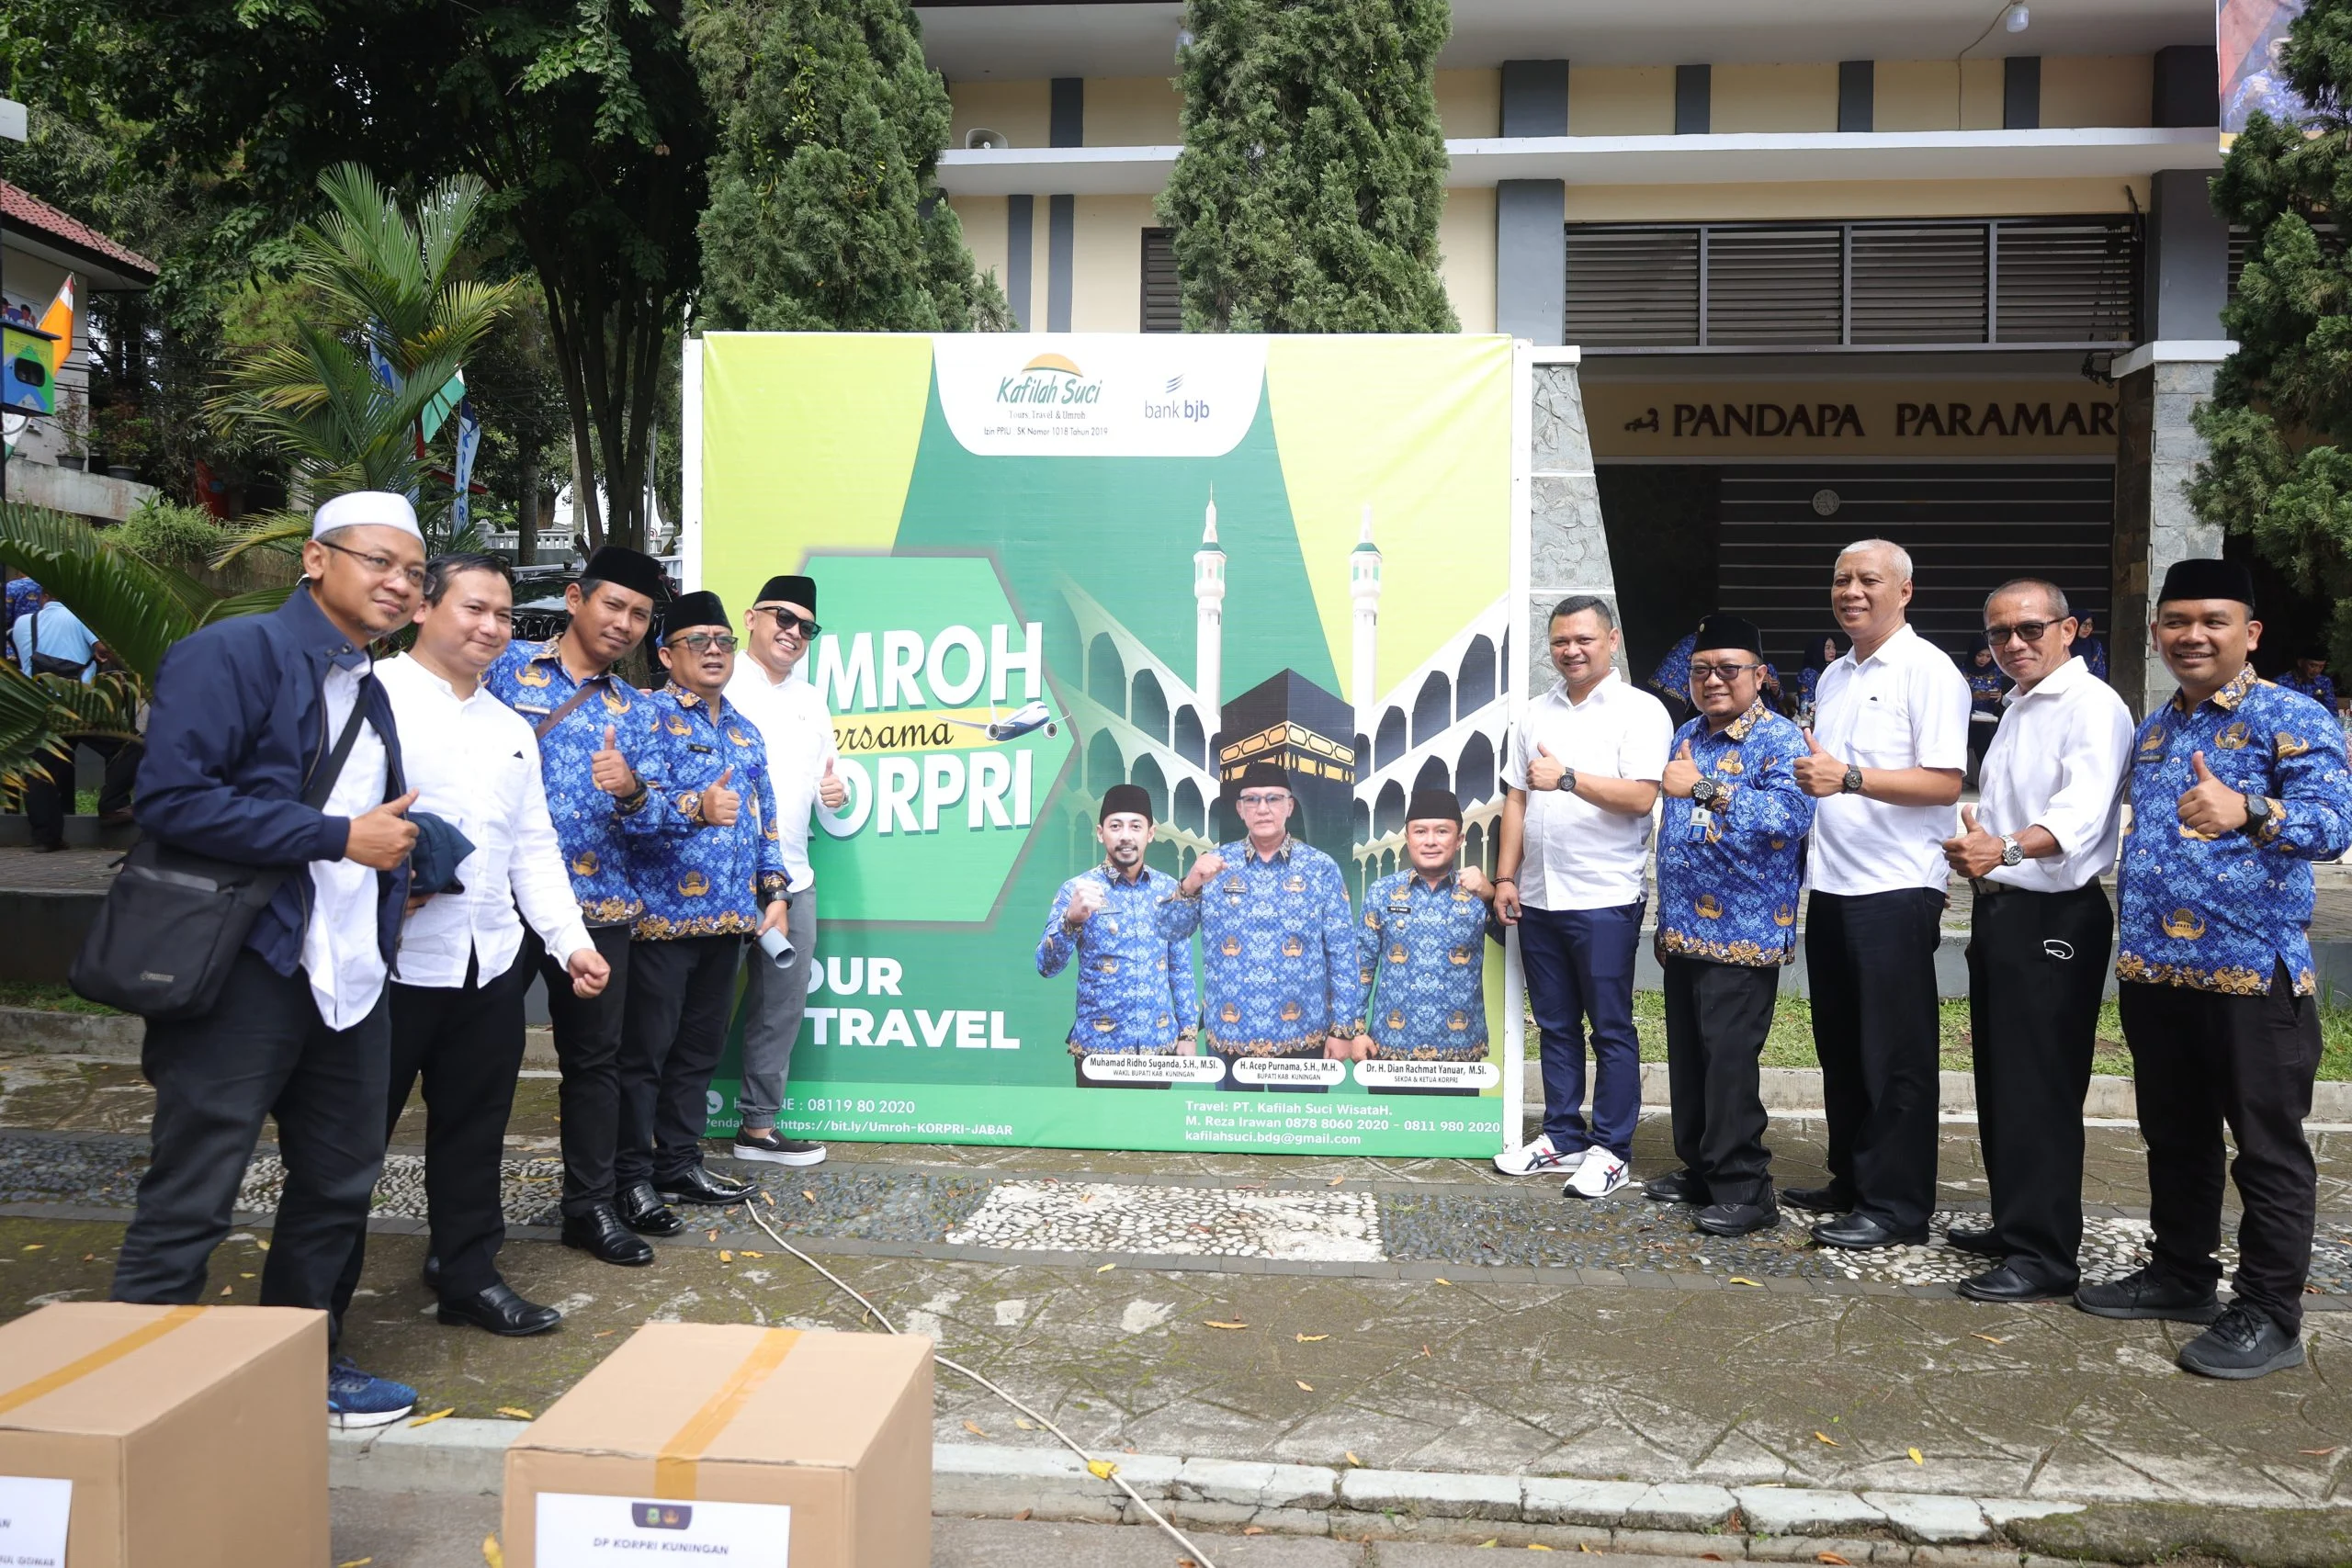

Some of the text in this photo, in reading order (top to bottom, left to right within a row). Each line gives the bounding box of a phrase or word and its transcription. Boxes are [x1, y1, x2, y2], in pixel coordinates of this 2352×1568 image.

[997, 376, 1102, 405] Kafilah Suci
[1032, 411, 1053, 420] Travel
[1056, 411, 1060, 419] &
[1062, 411, 1086, 420] Umroh
[1145, 400, 1209, 422] bank bjb
[1673, 402, 2120, 436] PANDAPA PARAMAR
[984, 427, 1109, 436] Izin PPIU SK Nomor 1018 Tahun 2019
[808, 621, 1042, 711] MROH
[835, 721, 955, 751] ersama
[814, 750, 1033, 837] ORPRI
[804, 1008, 1021, 1049] TRAVEL
[1090, 1057, 1125, 1067] Muhamad
[1126, 1058, 1148, 1067] Ridho
[1148, 1058, 1182, 1070] Suganda,
[1183, 1059, 1199, 1069] S.H.,
[1240, 1061, 1338, 1072] H. Acep Purnama, S.H., M.H.
[1366, 1064, 1377, 1073] Dr.
[1378, 1064, 1386, 1073] H.
[1387, 1064, 1404, 1073] Dian
[1406, 1064, 1437, 1074] Rachmat
[1438, 1065, 1466, 1075] Yanuar,
[808, 1099, 853, 1112] 08119
[856, 1100, 876, 1112] 80
[879, 1100, 915, 1113] 2020
[1185, 1101, 1393, 1116] Travel: PT. Kafilah Suci WisataH.
[1185, 1116, 1201, 1126] M.
[1205, 1116, 1235, 1126] Reza
[1239, 1117, 1281, 1127] Irawan
[1285, 1118, 1317, 1128] 0878
[1321, 1119, 1352, 1129] 8060
[1357, 1120, 1389, 1130] 2020
[1404, 1120, 1436, 1131] 0811
[1441, 1121, 1464, 1132] 980
[1468, 1122, 1500, 1133] 2020
[1185, 1131, 1361, 1145] kafilahsuci.bdg@gmail.com
[593, 1538, 729, 1555] DP KORPRI KUNINGAN
